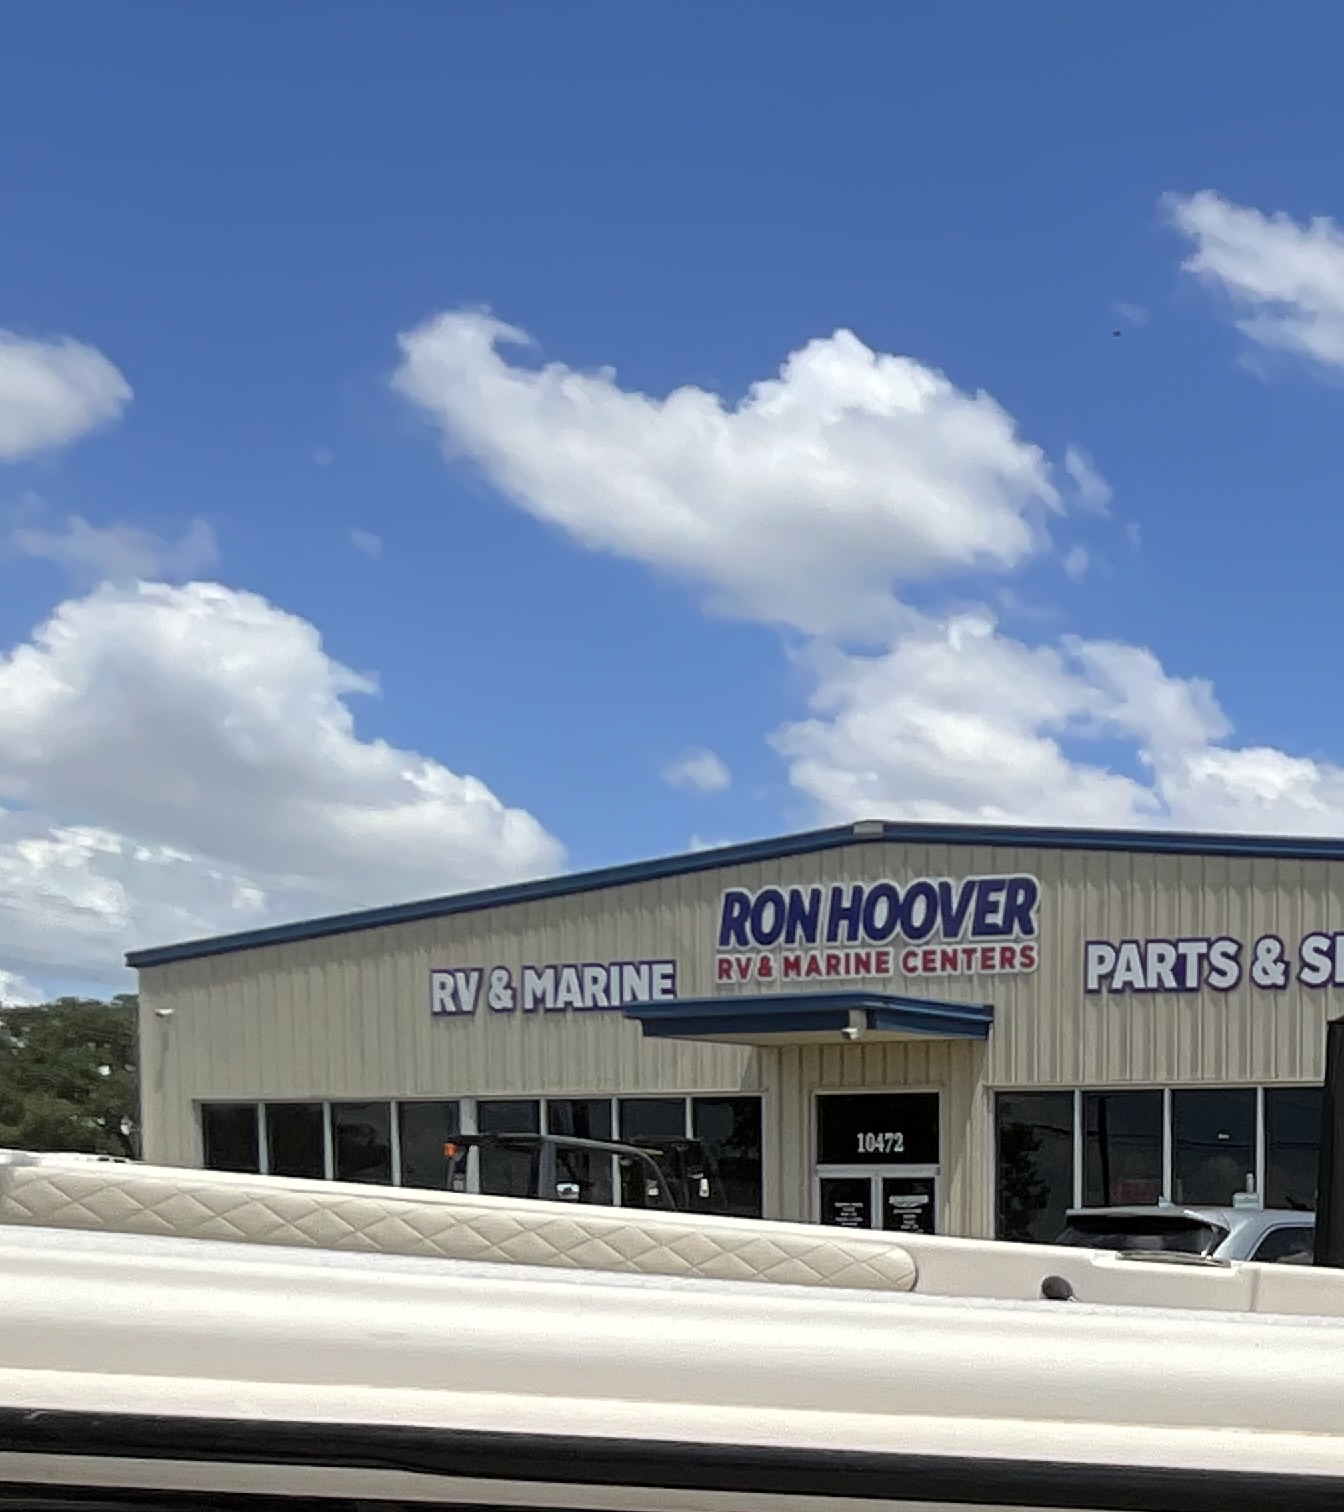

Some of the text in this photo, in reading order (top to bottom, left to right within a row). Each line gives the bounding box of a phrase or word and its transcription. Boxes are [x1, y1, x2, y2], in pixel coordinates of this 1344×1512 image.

[718, 877, 1038, 947] RON HOOVER
[430, 961, 676, 1014] RV & MARINE
[717, 944, 1037, 981] RV & MARINE CENTERS
[1085, 938, 1241, 992] PARTS
[1251, 935, 1288, 989] &
[856, 1132, 905, 1154] 10472
